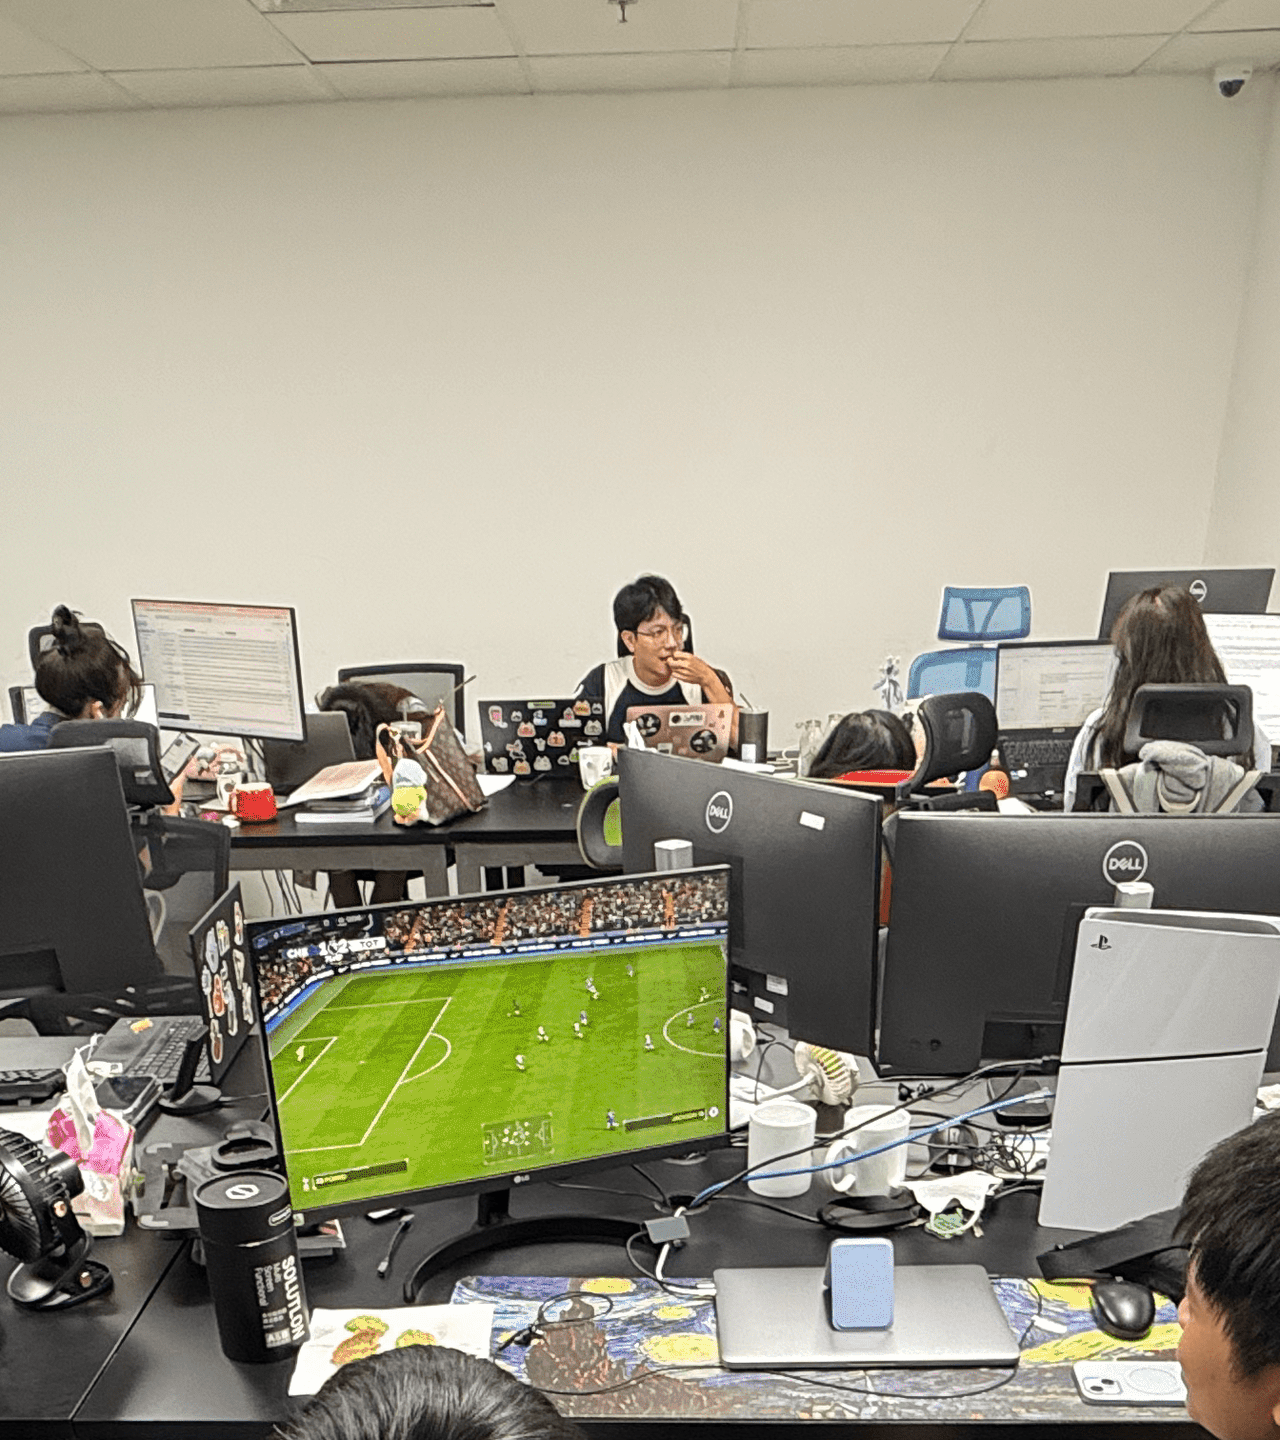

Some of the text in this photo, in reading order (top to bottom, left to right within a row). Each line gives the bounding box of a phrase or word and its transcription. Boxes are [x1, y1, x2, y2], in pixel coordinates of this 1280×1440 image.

[1108, 857, 1143, 871] DELL
[359, 939, 379, 949] TOT
[254, 1266, 269, 1307] Functional
[263, 1265, 275, 1293] Screen
